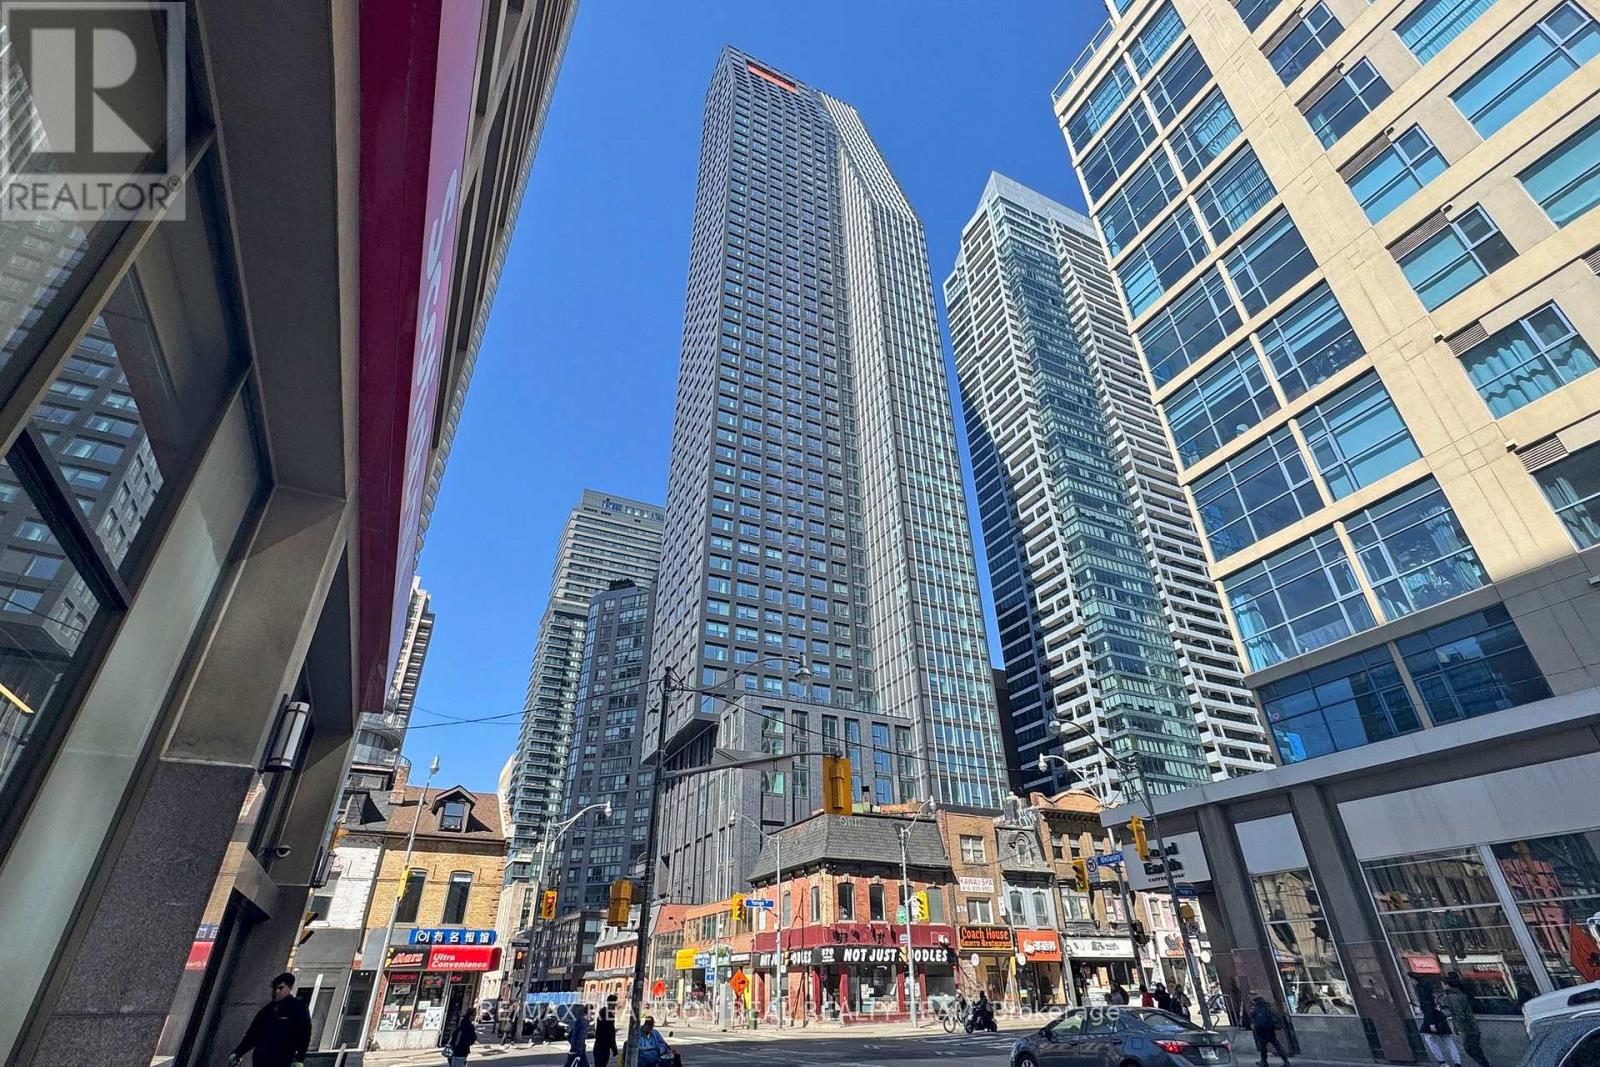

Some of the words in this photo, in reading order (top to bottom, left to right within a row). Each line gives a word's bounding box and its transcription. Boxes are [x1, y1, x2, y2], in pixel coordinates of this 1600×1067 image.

[961, 927, 985, 940] Coach
[986, 927, 1009, 940] House
[433, 953, 456, 961] Ultra
[844, 949, 866, 962] NOT
[869, 949, 897, 962] JUST
[911, 949, 948, 962] ODLES
[431, 960, 487, 968] Convenience
